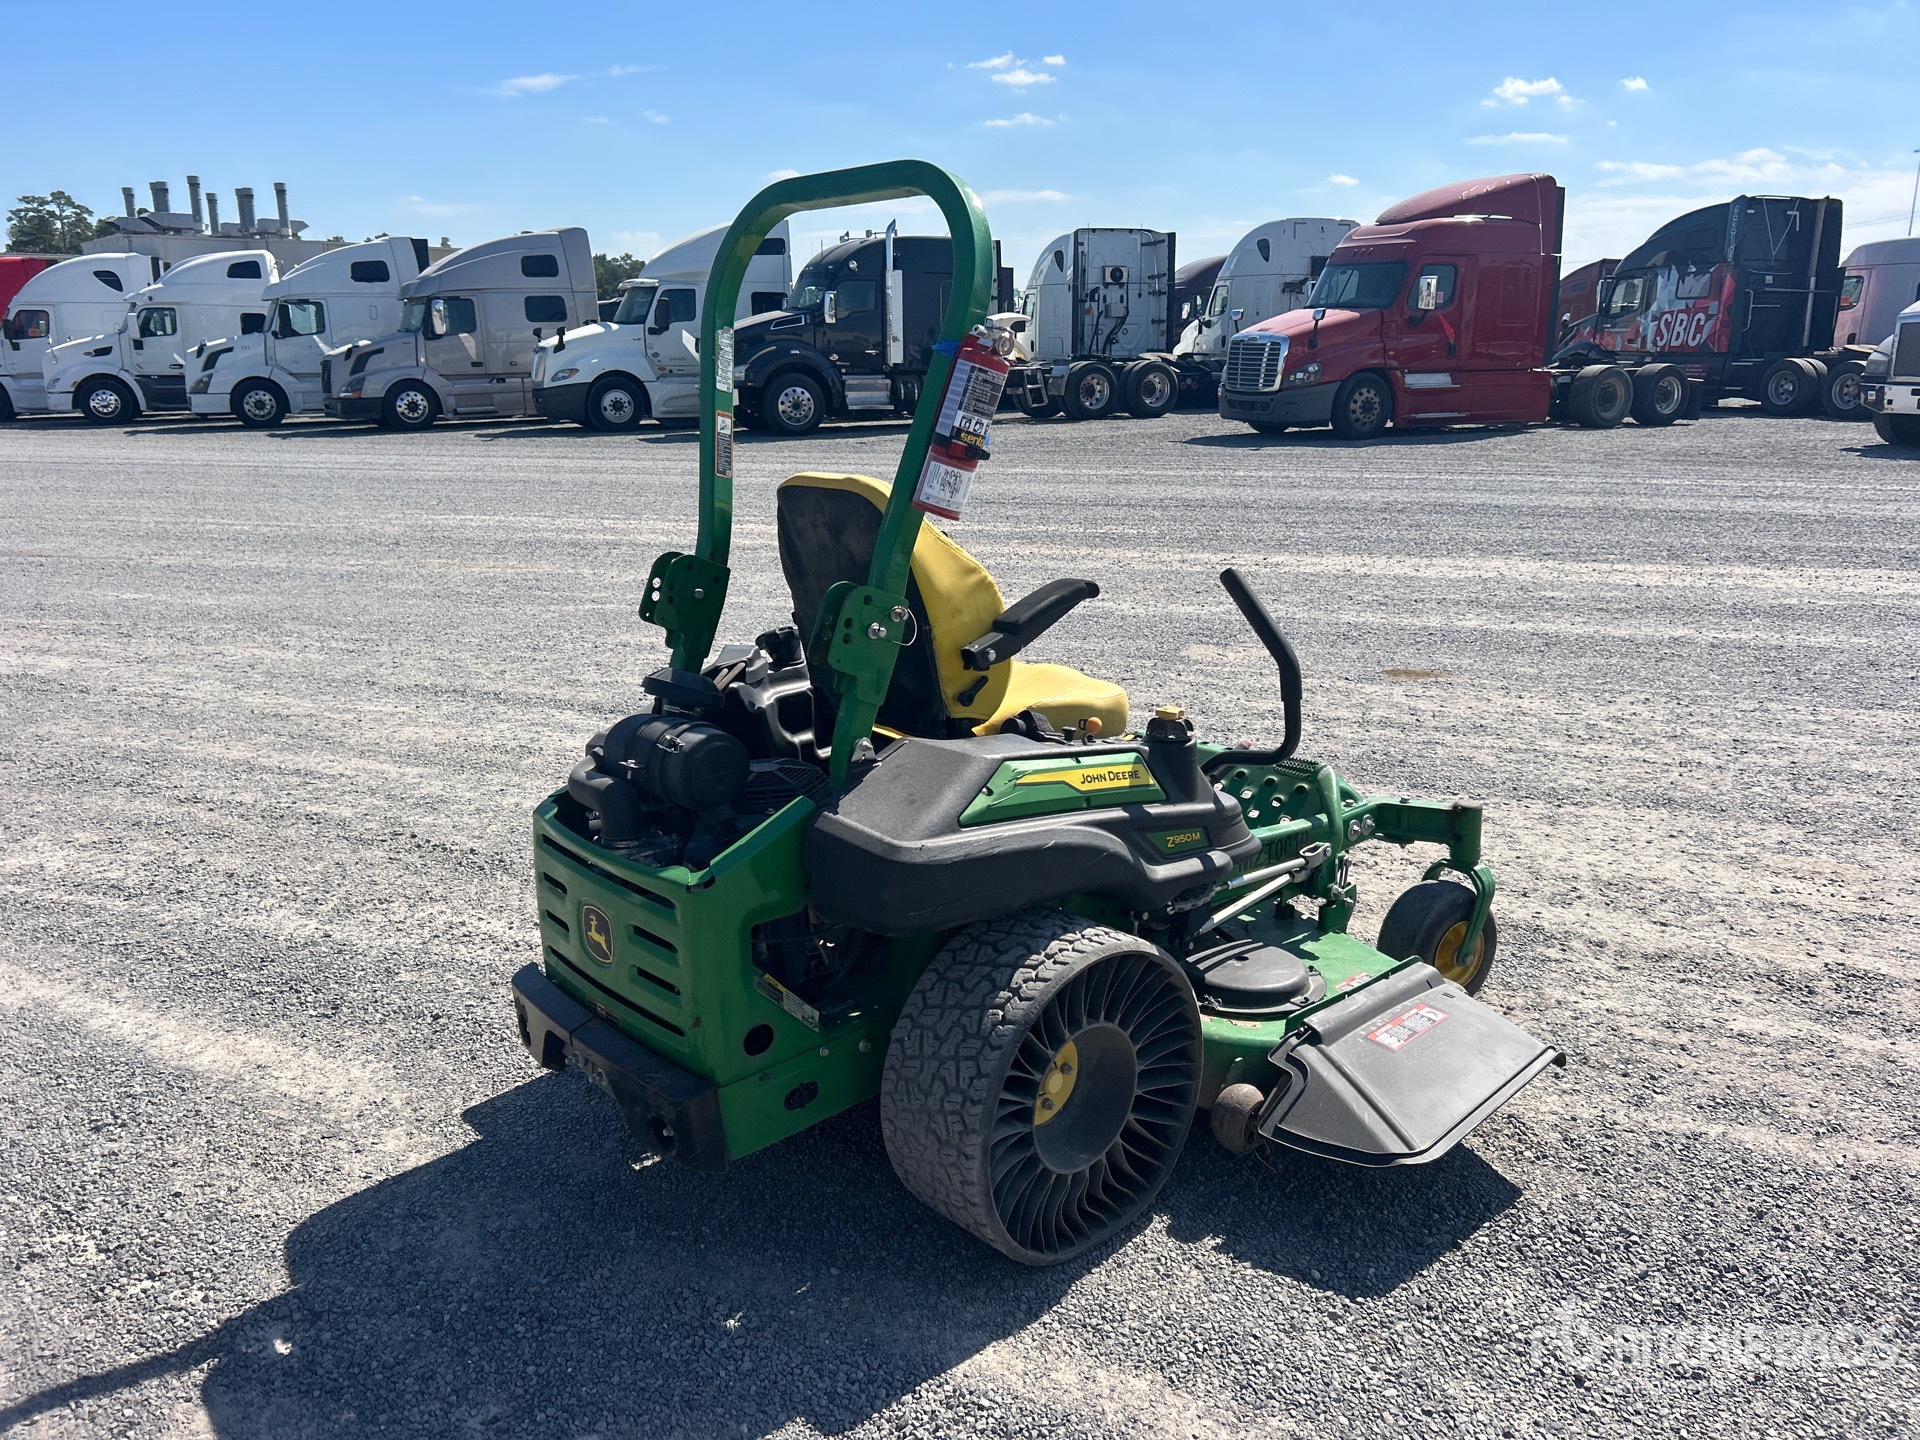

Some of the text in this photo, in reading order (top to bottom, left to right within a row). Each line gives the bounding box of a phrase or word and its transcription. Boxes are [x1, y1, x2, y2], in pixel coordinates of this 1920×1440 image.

[1080, 770, 1140, 785] JOHN DEERE
[1166, 832, 1201, 848] Z950M
